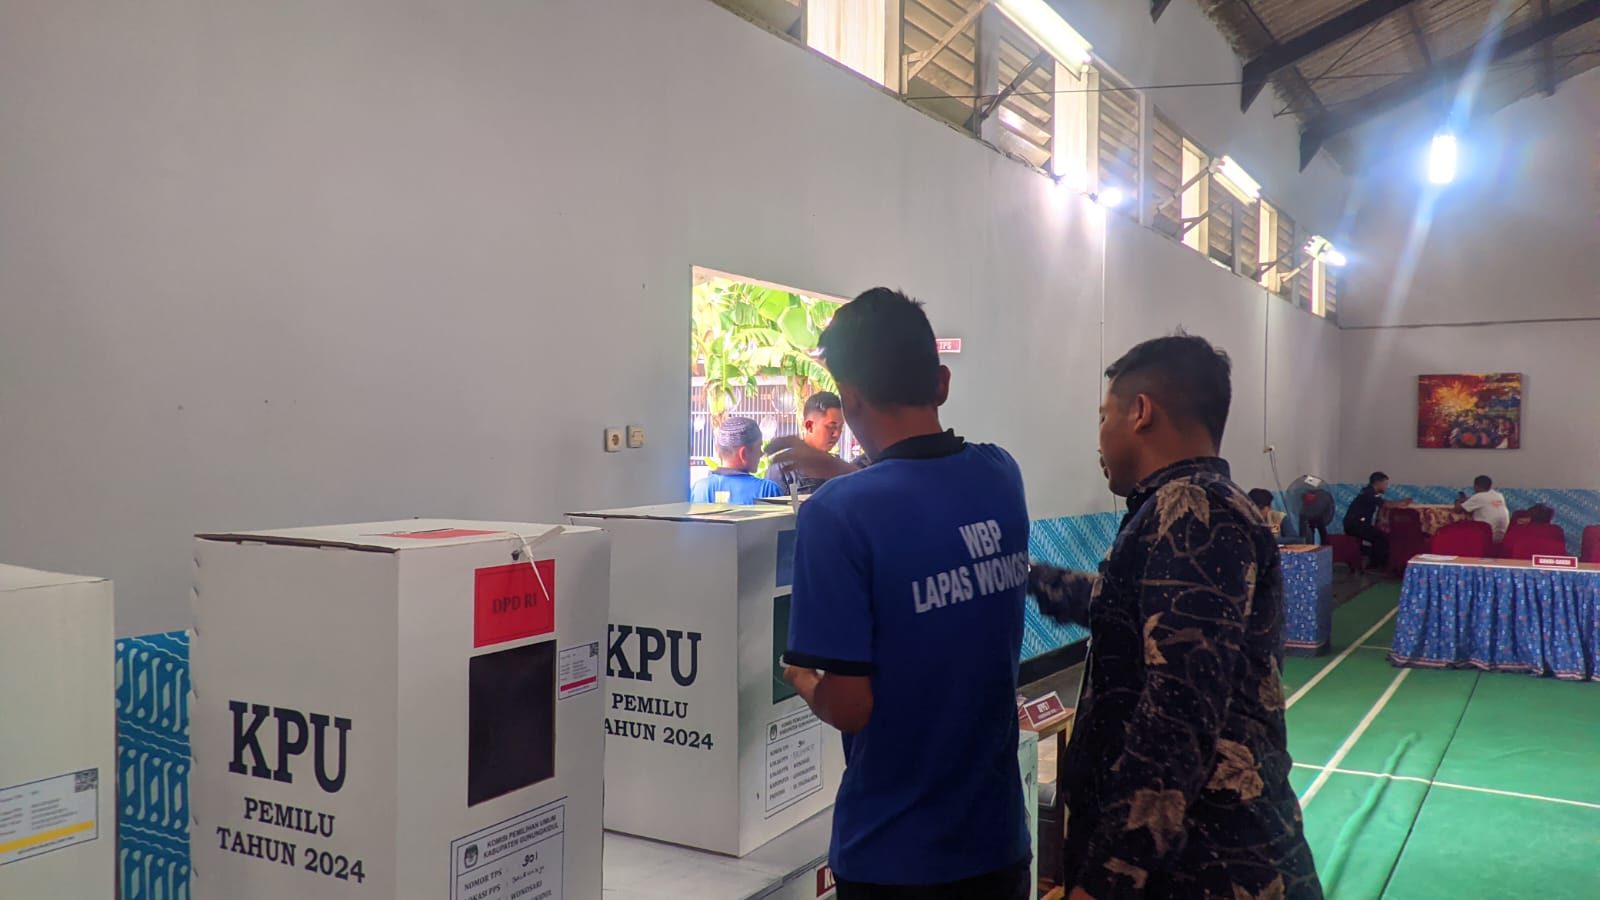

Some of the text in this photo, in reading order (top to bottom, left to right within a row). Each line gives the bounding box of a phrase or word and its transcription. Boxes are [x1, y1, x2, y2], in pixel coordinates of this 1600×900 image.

[958, 519, 1002, 559] WBP
[492, 592, 537, 614] DPD RI
[912, 565, 974, 614] LAPAS
[606, 623, 702, 687] KPU
[611, 692, 689, 719] PEMILU
[228, 699, 352, 794] KPU
[663, 726, 714, 750] 2024
[243, 797, 335, 838] PEMILU
[508, 823, 539, 838] PEMILIHAN
[216, 826, 366, 884] TAHUN 2024
[484, 839, 519, 857] KABUPATEN
[464, 875, 489, 891] NOMOR
[490, 868, 503, 879] TPS
